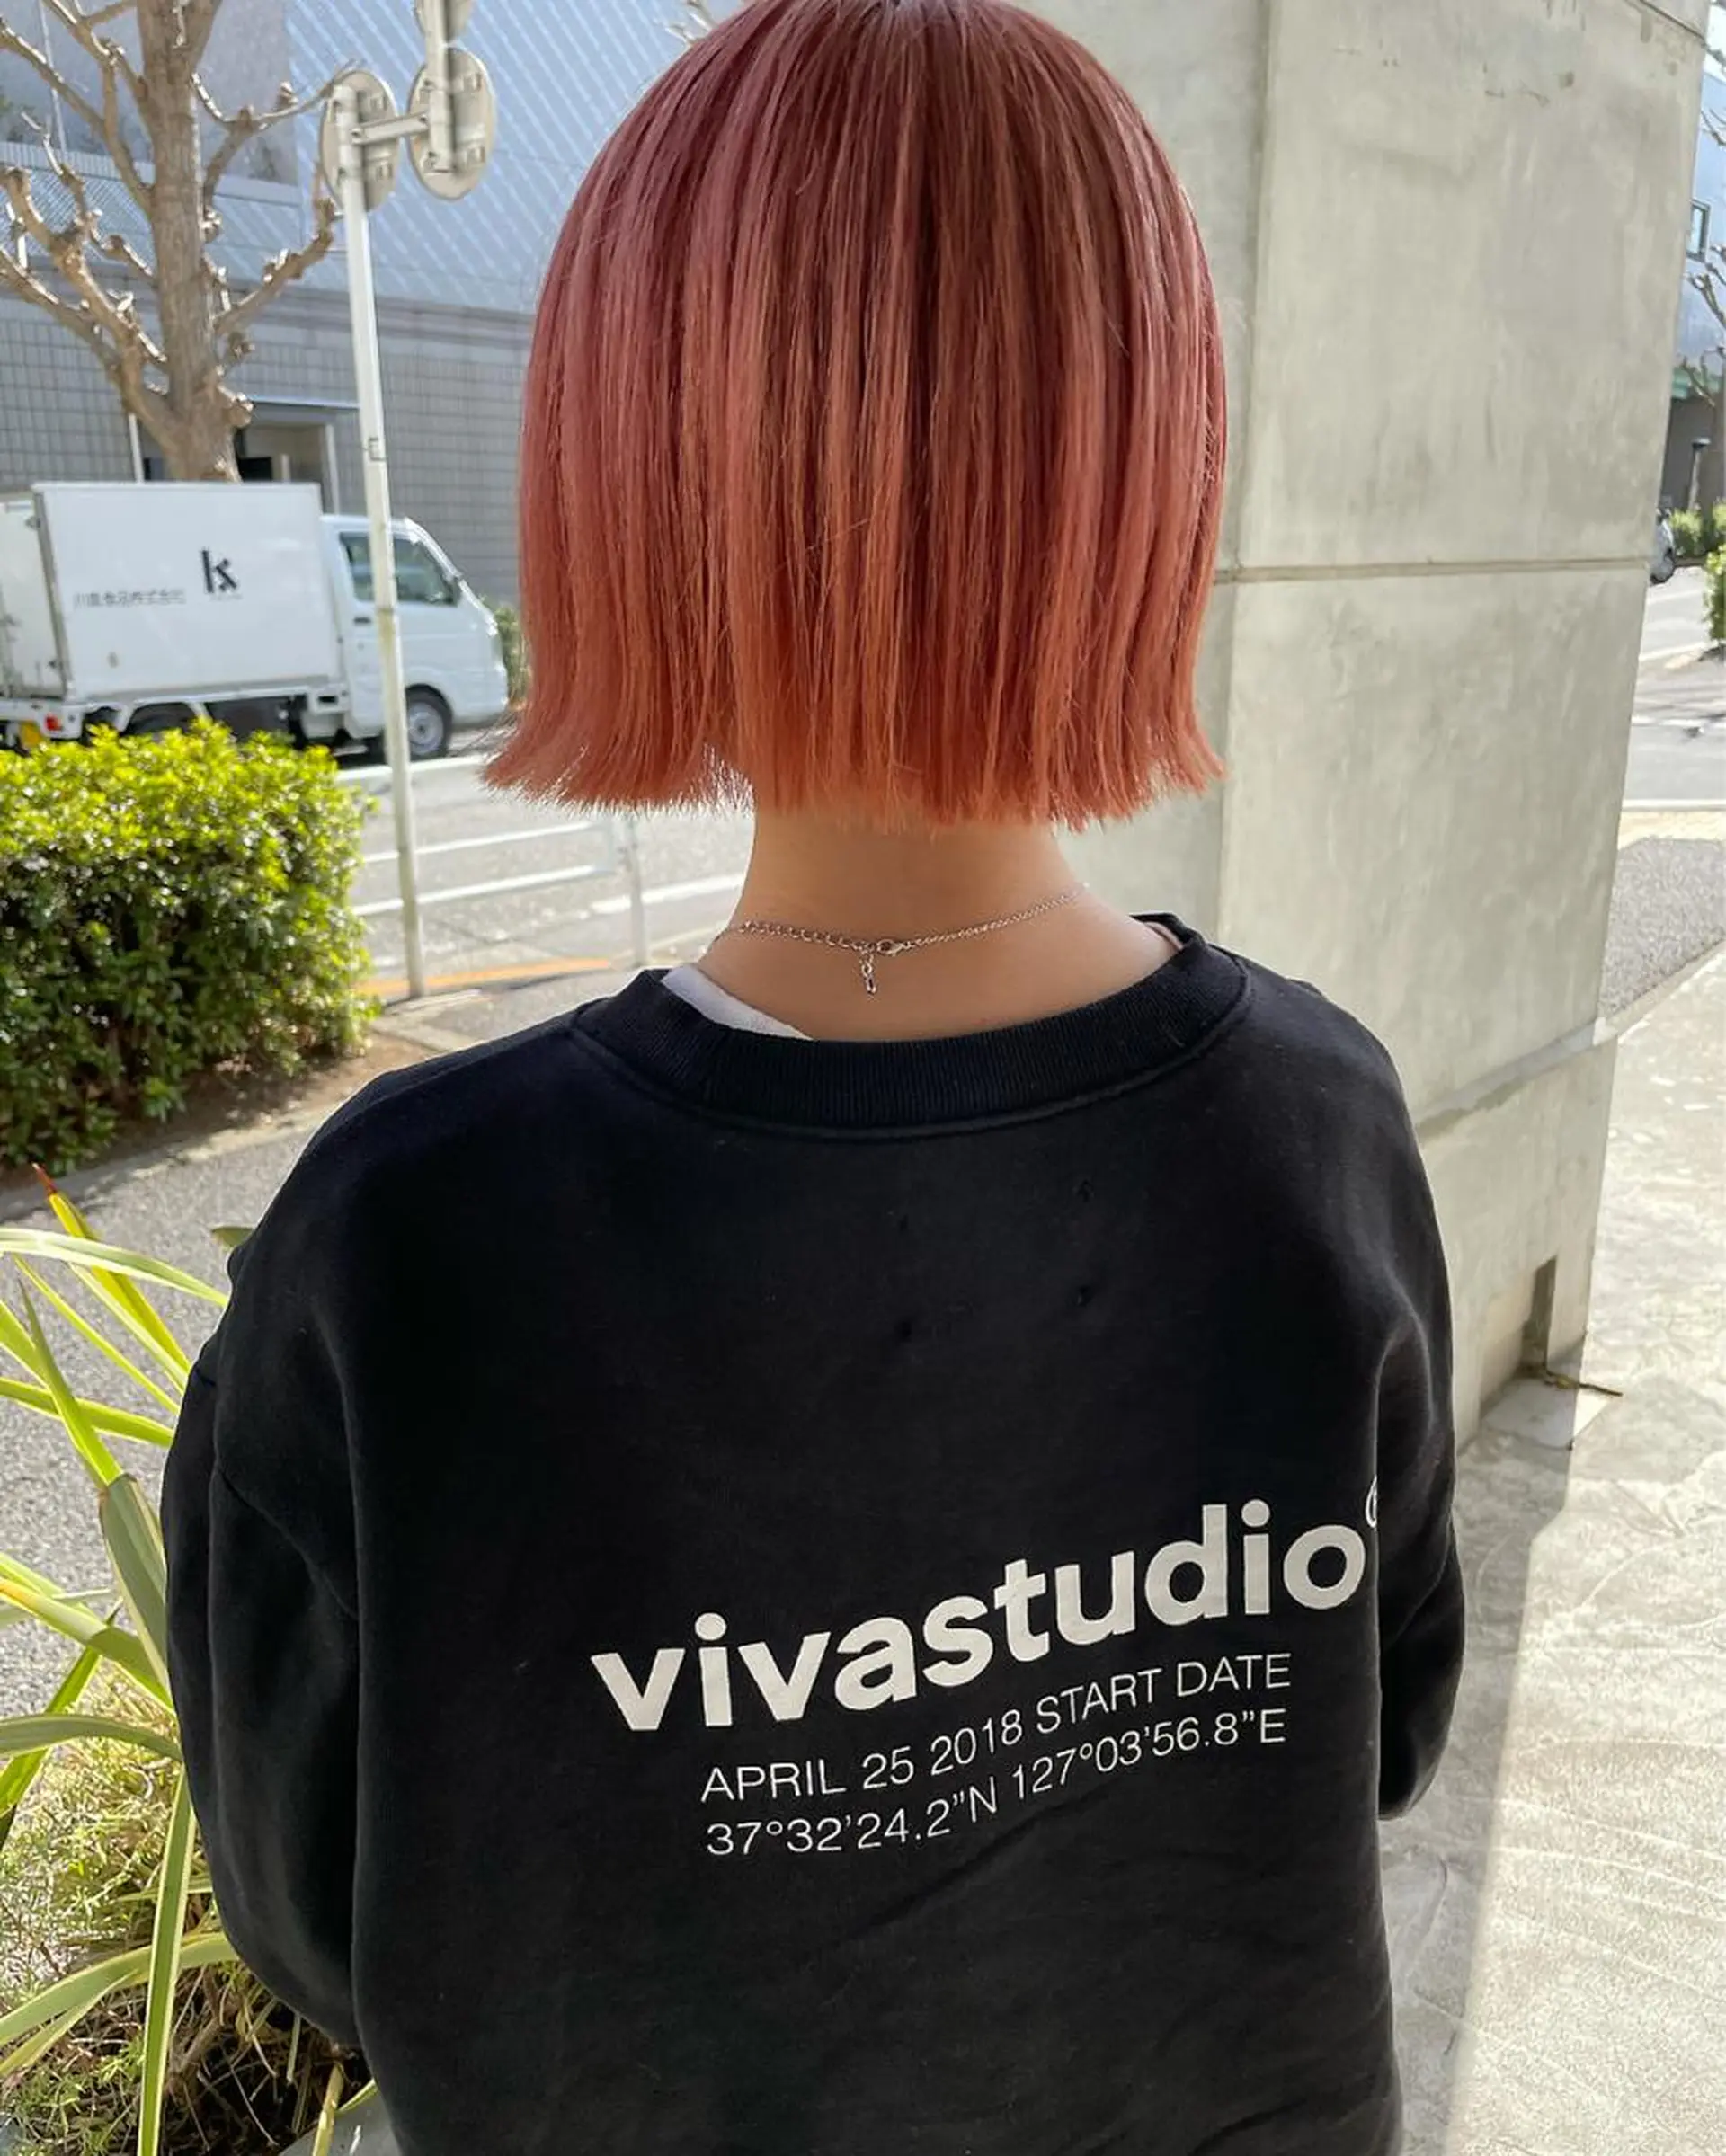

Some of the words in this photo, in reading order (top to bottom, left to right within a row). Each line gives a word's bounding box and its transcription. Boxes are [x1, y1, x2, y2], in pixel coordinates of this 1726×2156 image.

[590, 1499, 1366, 1731] vivastudio
[700, 1759, 847, 1803] APRIL
[862, 1745, 914, 1789] 25
[930, 1708, 1023, 1776] 2018
[1036, 1667, 1162, 1734] START
[1177, 1653, 1291, 1697] DATE
